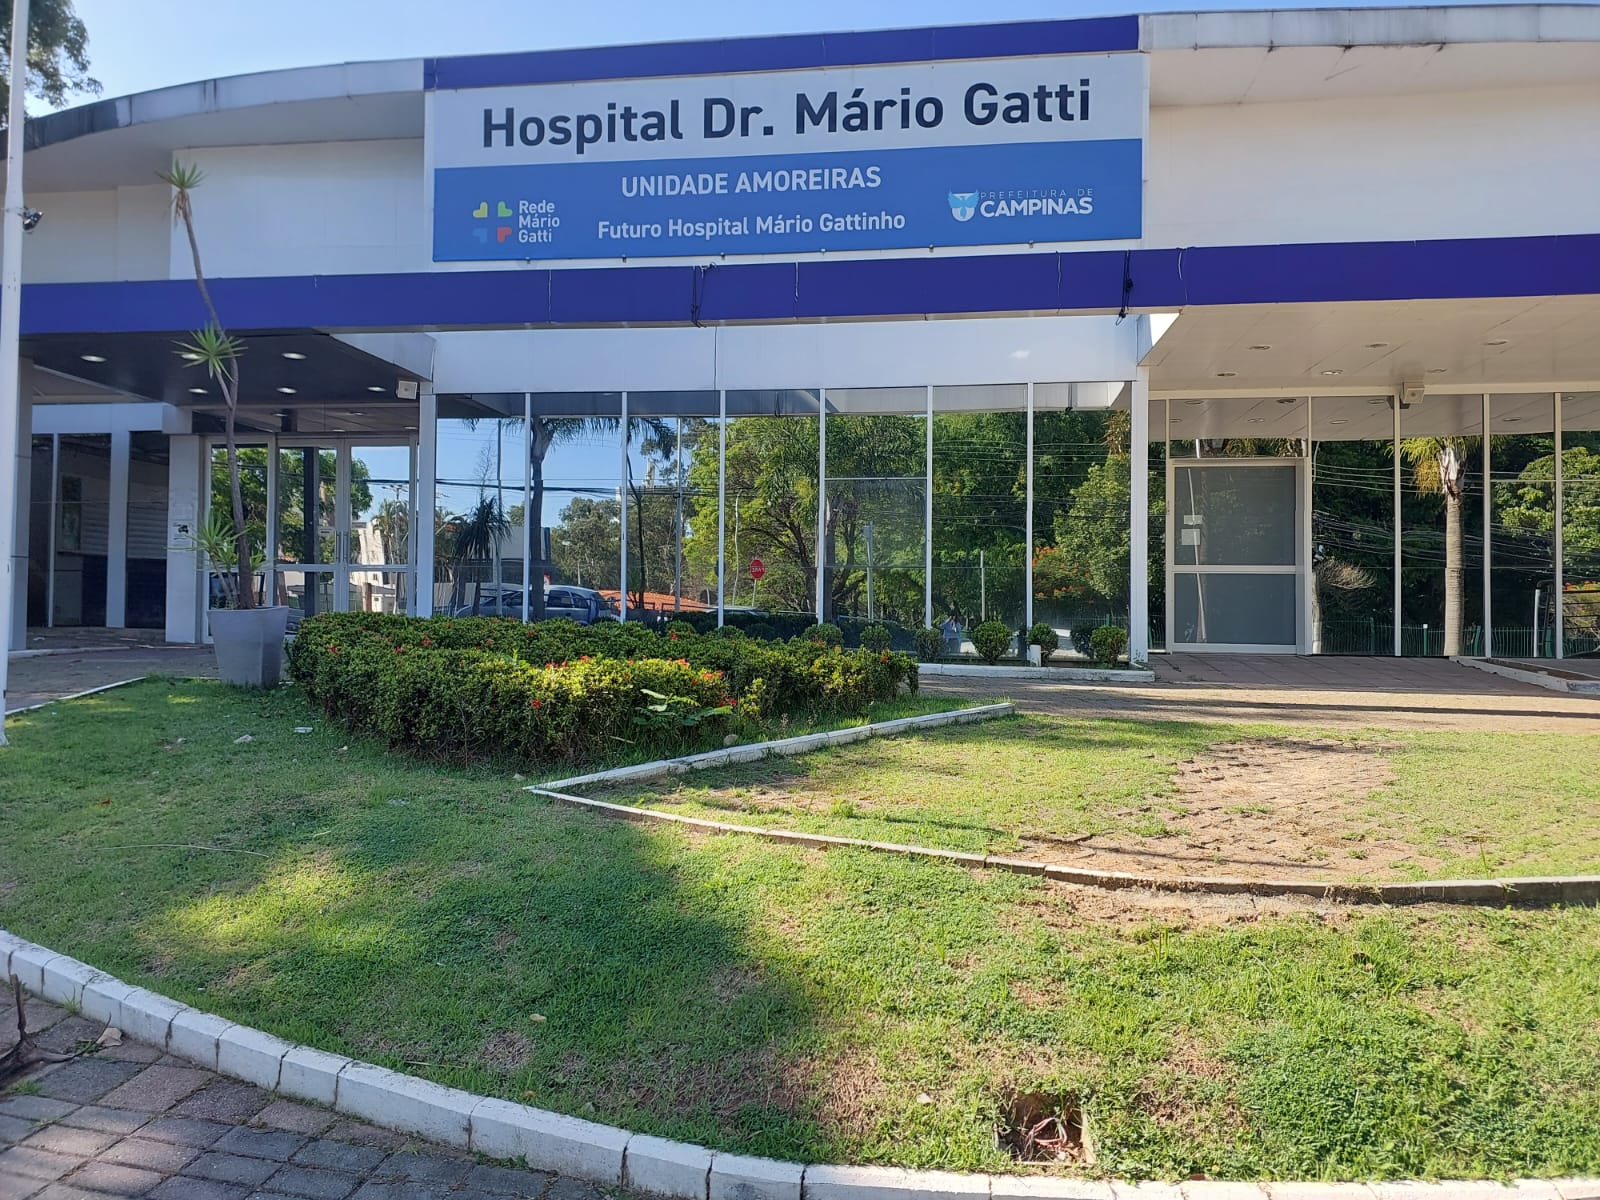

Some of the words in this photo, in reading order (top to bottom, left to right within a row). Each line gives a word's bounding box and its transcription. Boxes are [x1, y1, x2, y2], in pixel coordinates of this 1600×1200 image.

[483, 99, 683, 154] Hospital
[703, 97, 774, 139] Dr.
[795, 87, 944, 134] Mário
[964, 78, 1090, 126] Gatti
[621, 173, 729, 198] UNIDADE
[734, 166, 882, 194] AMOREIRAS
[980, 187, 1067, 200] PREFEITURA
[1077, 188, 1093, 197] DE
[519, 200, 555, 214] Rede
[980, 197, 1093, 218] CAMPINAS
[518, 213, 560, 229] Mário
[598, 220, 662, 240] Futuro
[668, 217, 750, 241] Hospital
[756, 214, 813, 235] Mário
[819, 211, 906, 233] Gattinho
[518, 229, 552, 243] Gatti
